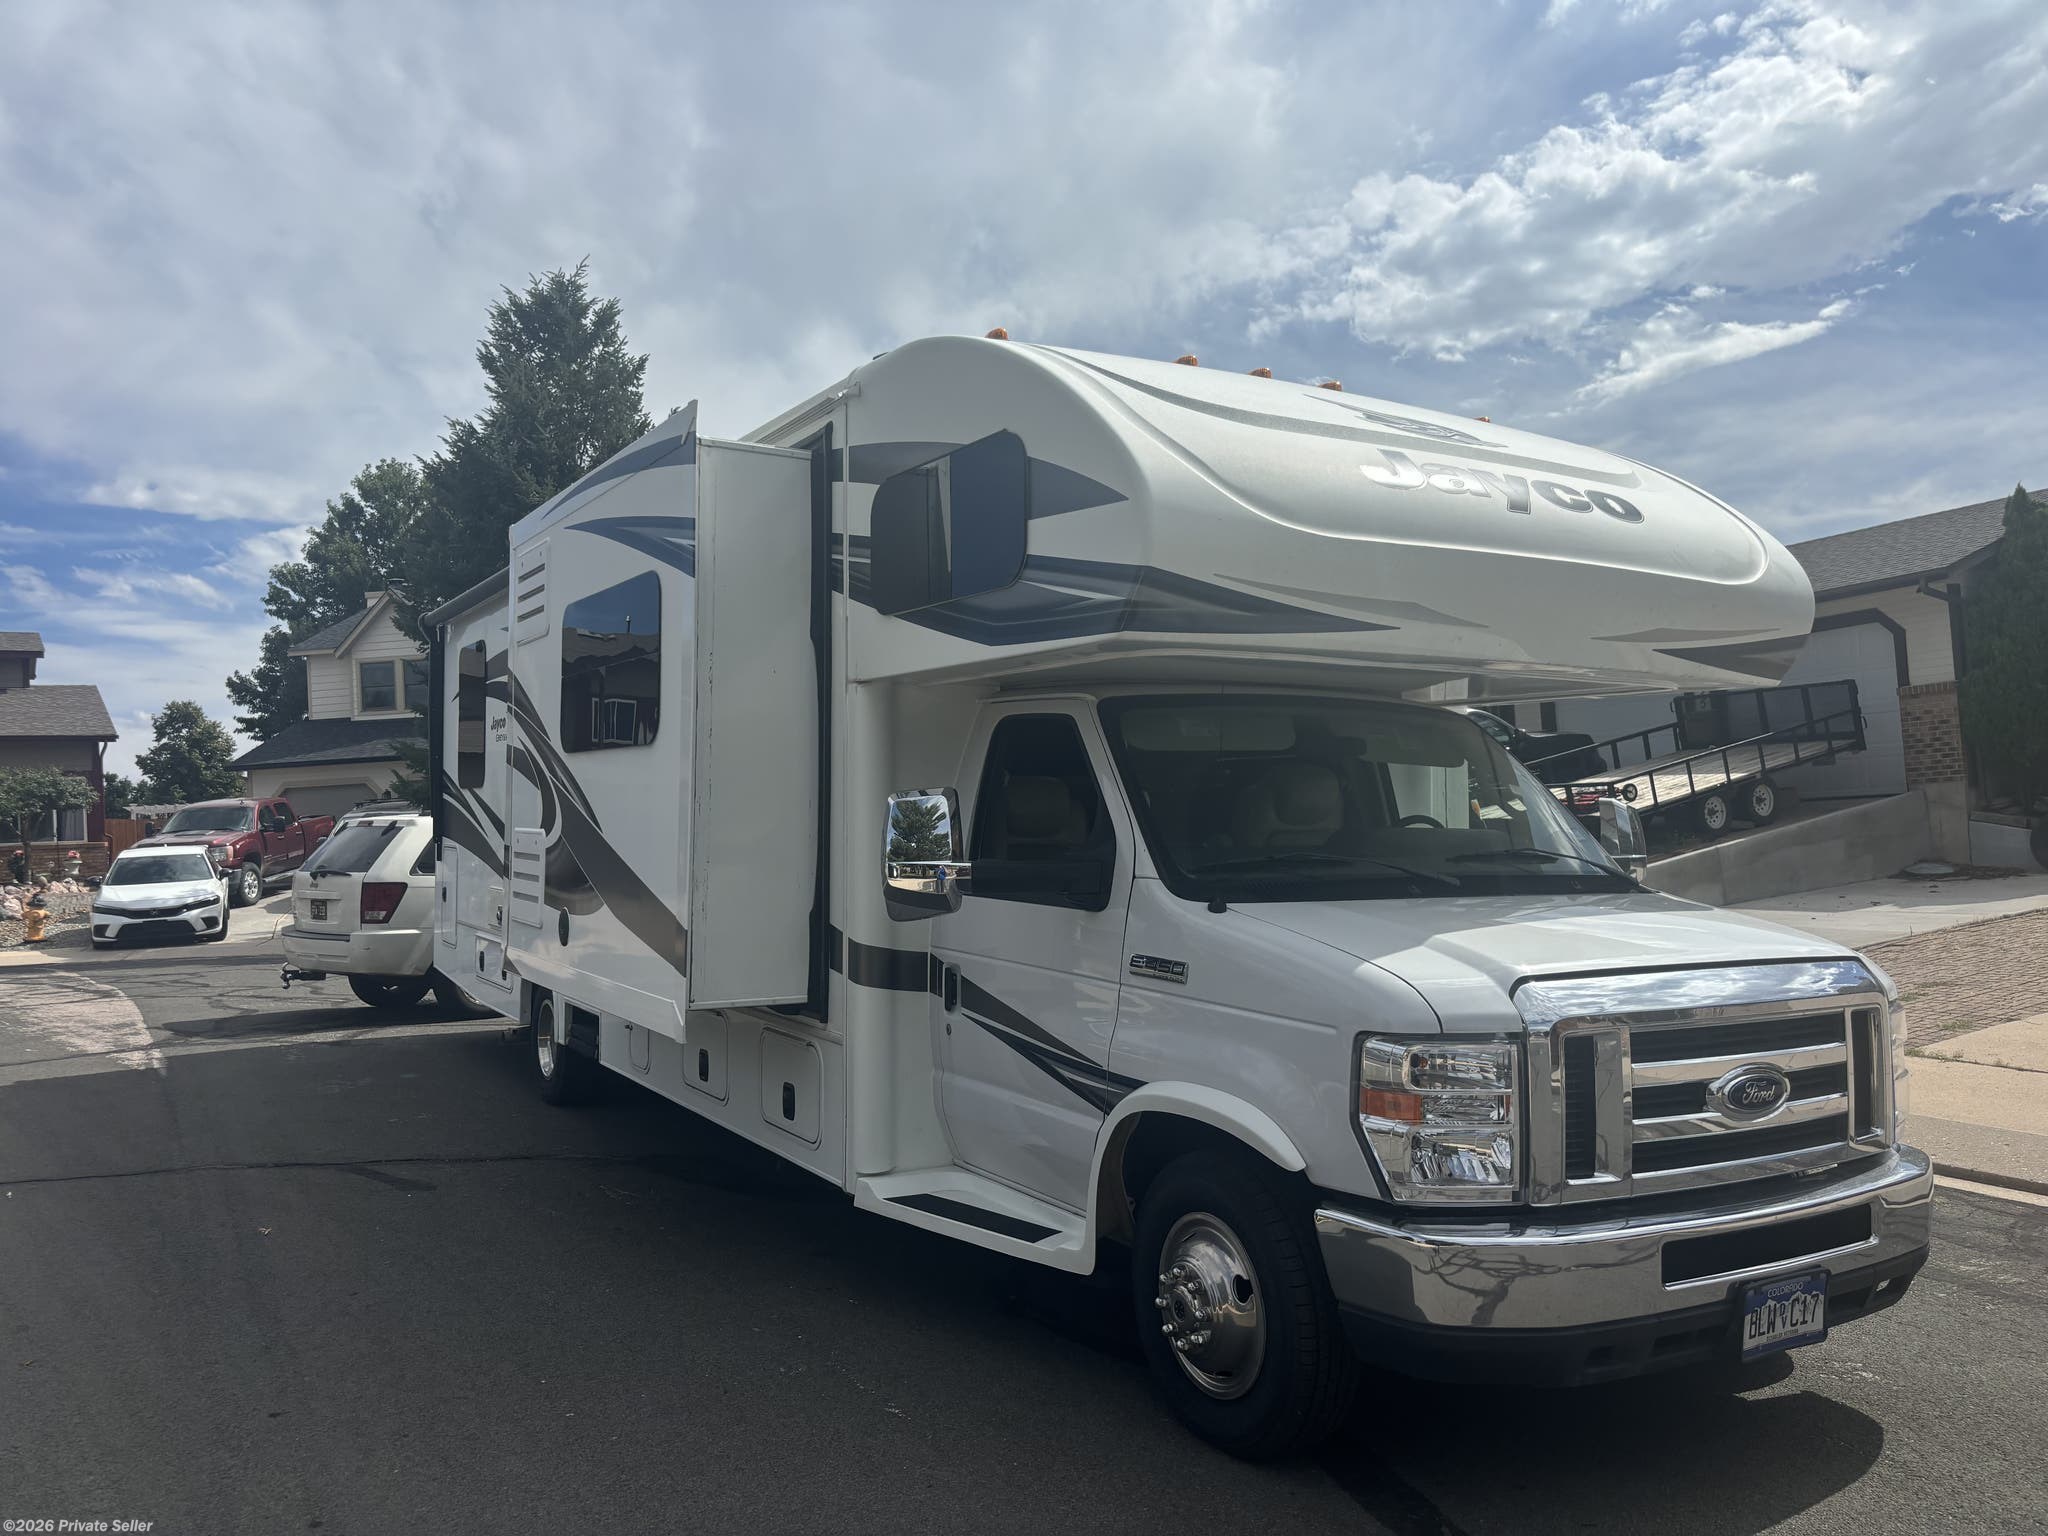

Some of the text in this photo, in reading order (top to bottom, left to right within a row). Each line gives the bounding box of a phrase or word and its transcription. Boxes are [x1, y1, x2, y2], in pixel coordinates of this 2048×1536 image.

[1359, 448, 1646, 524] Jayco
[1742, 1081, 1776, 1104] Ford
[1766, 1281, 1804, 1298] COLORADO
